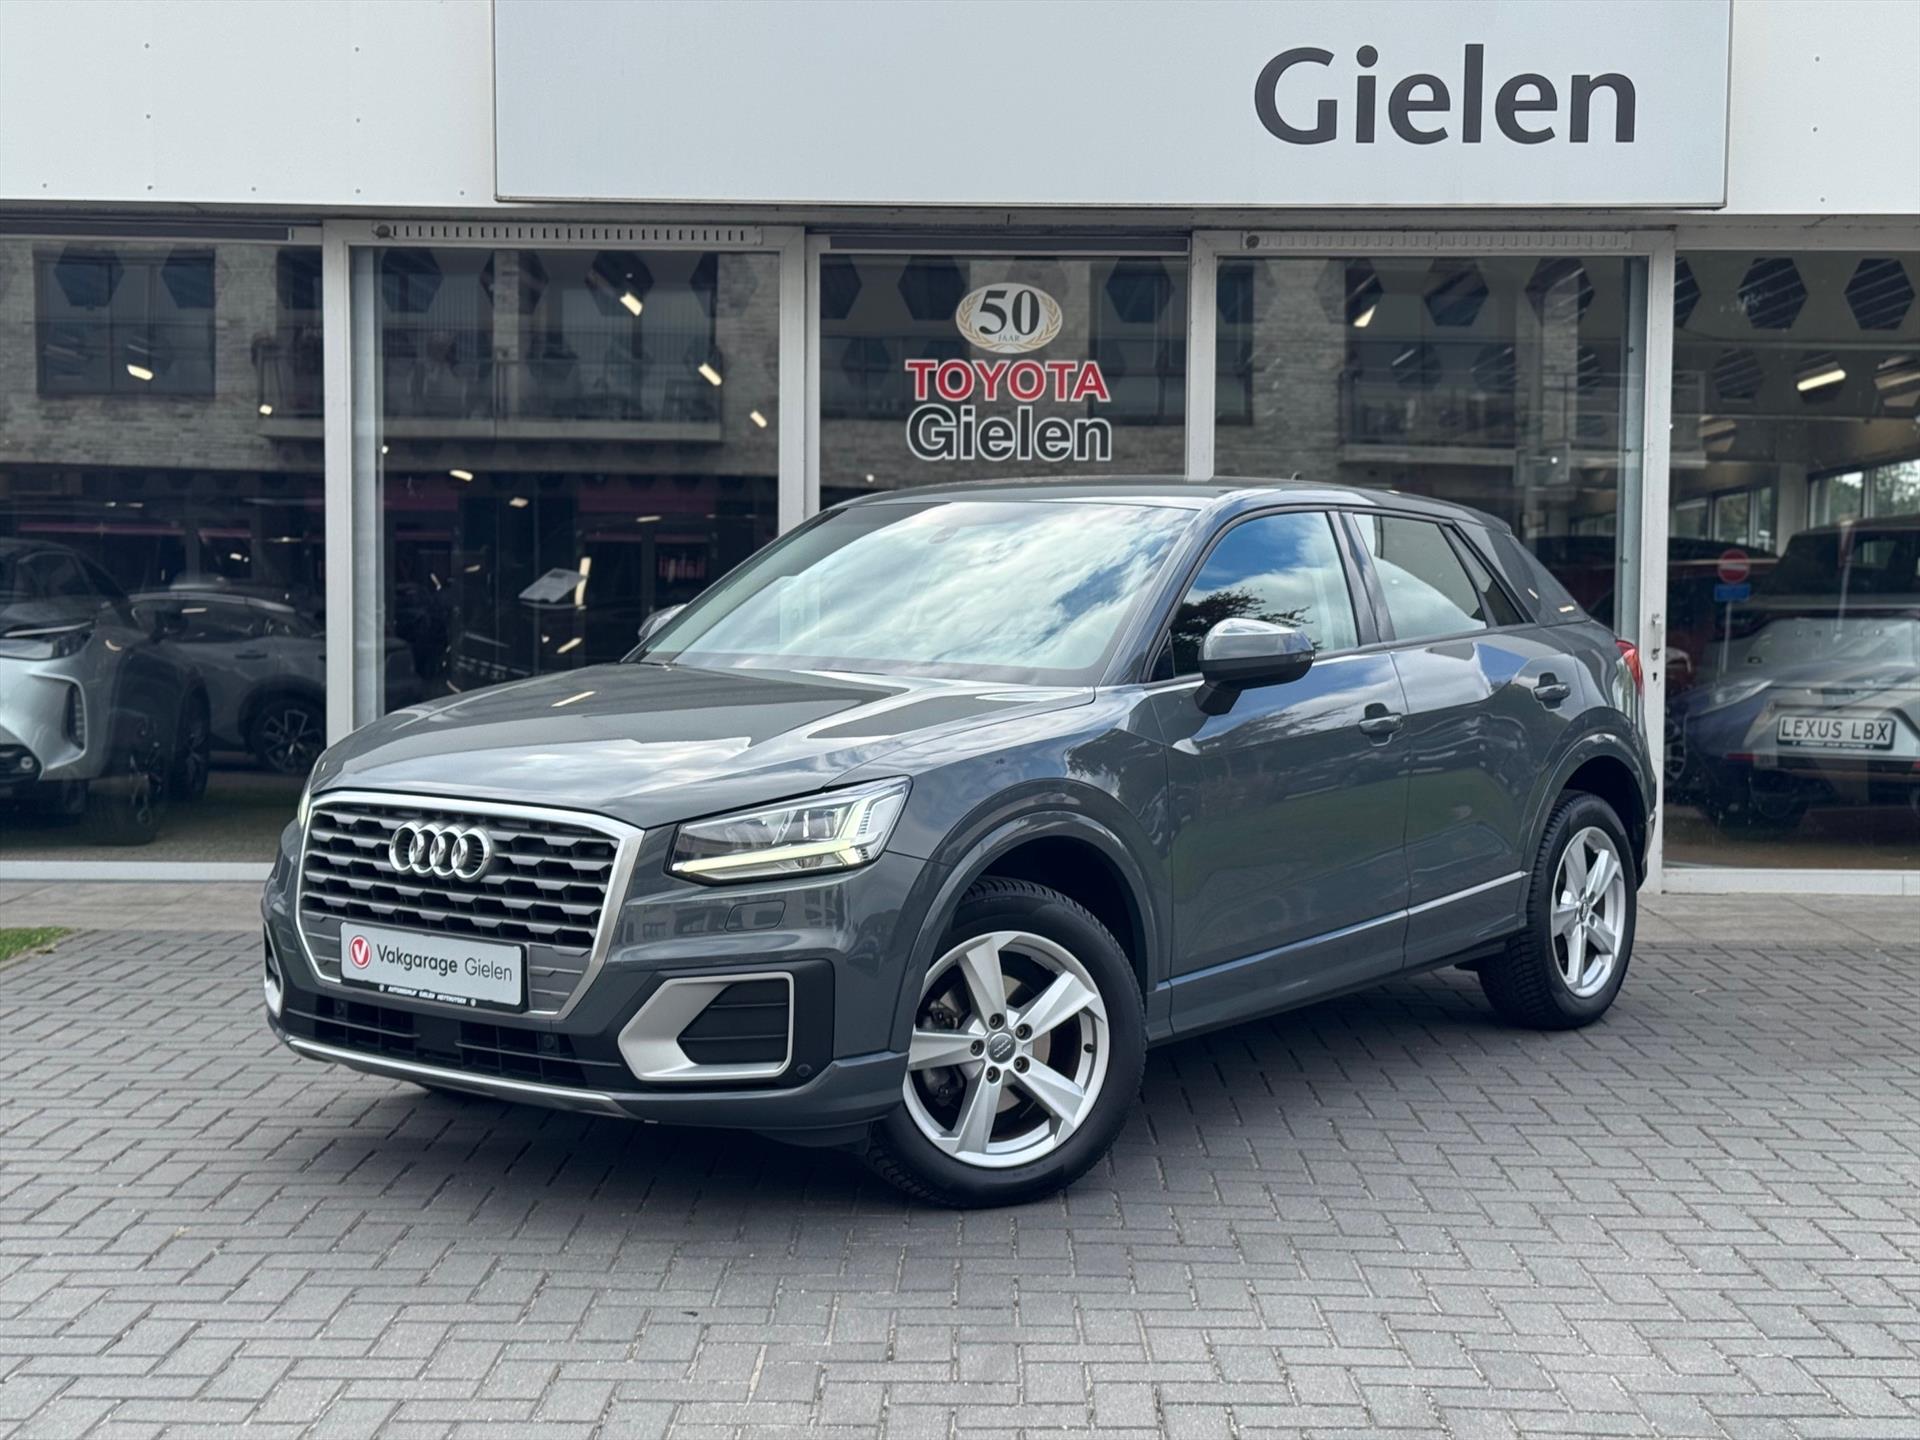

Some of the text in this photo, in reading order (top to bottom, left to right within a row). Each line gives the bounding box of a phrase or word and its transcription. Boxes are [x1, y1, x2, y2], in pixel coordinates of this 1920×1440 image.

[1254, 43, 1636, 145] Gielen
[978, 289, 1040, 336] 50
[998, 334, 1020, 342] JAAR
[905, 359, 1111, 402] TOYOTA
[906, 403, 1112, 462] Gielen
[1781, 720, 1889, 741] LEXUS LBX
[377, 944, 512, 982] Vakgarage Gielen
